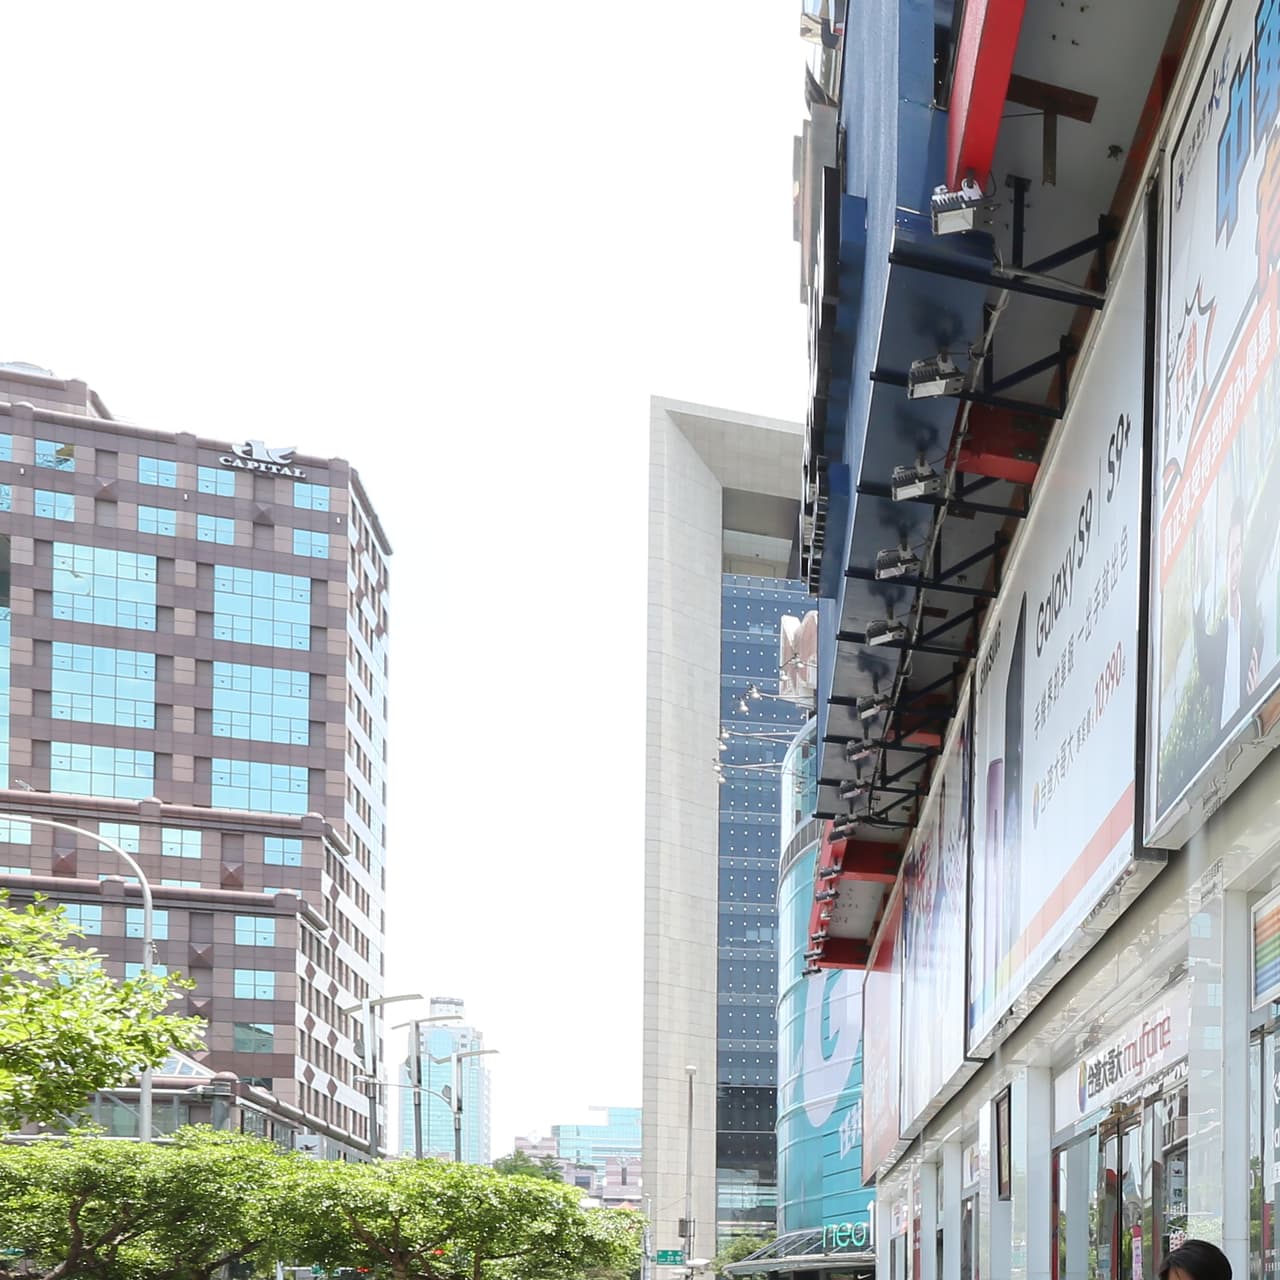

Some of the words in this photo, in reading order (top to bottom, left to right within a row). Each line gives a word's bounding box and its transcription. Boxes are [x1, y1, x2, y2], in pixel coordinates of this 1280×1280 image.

[219, 456, 307, 479] CAPITAL
[1037, 535, 1077, 659] Galaxy
[1078, 488, 1093, 571] S9
[1108, 412, 1133, 503] S9+
[1124, 1016, 1171, 1077] myfone
